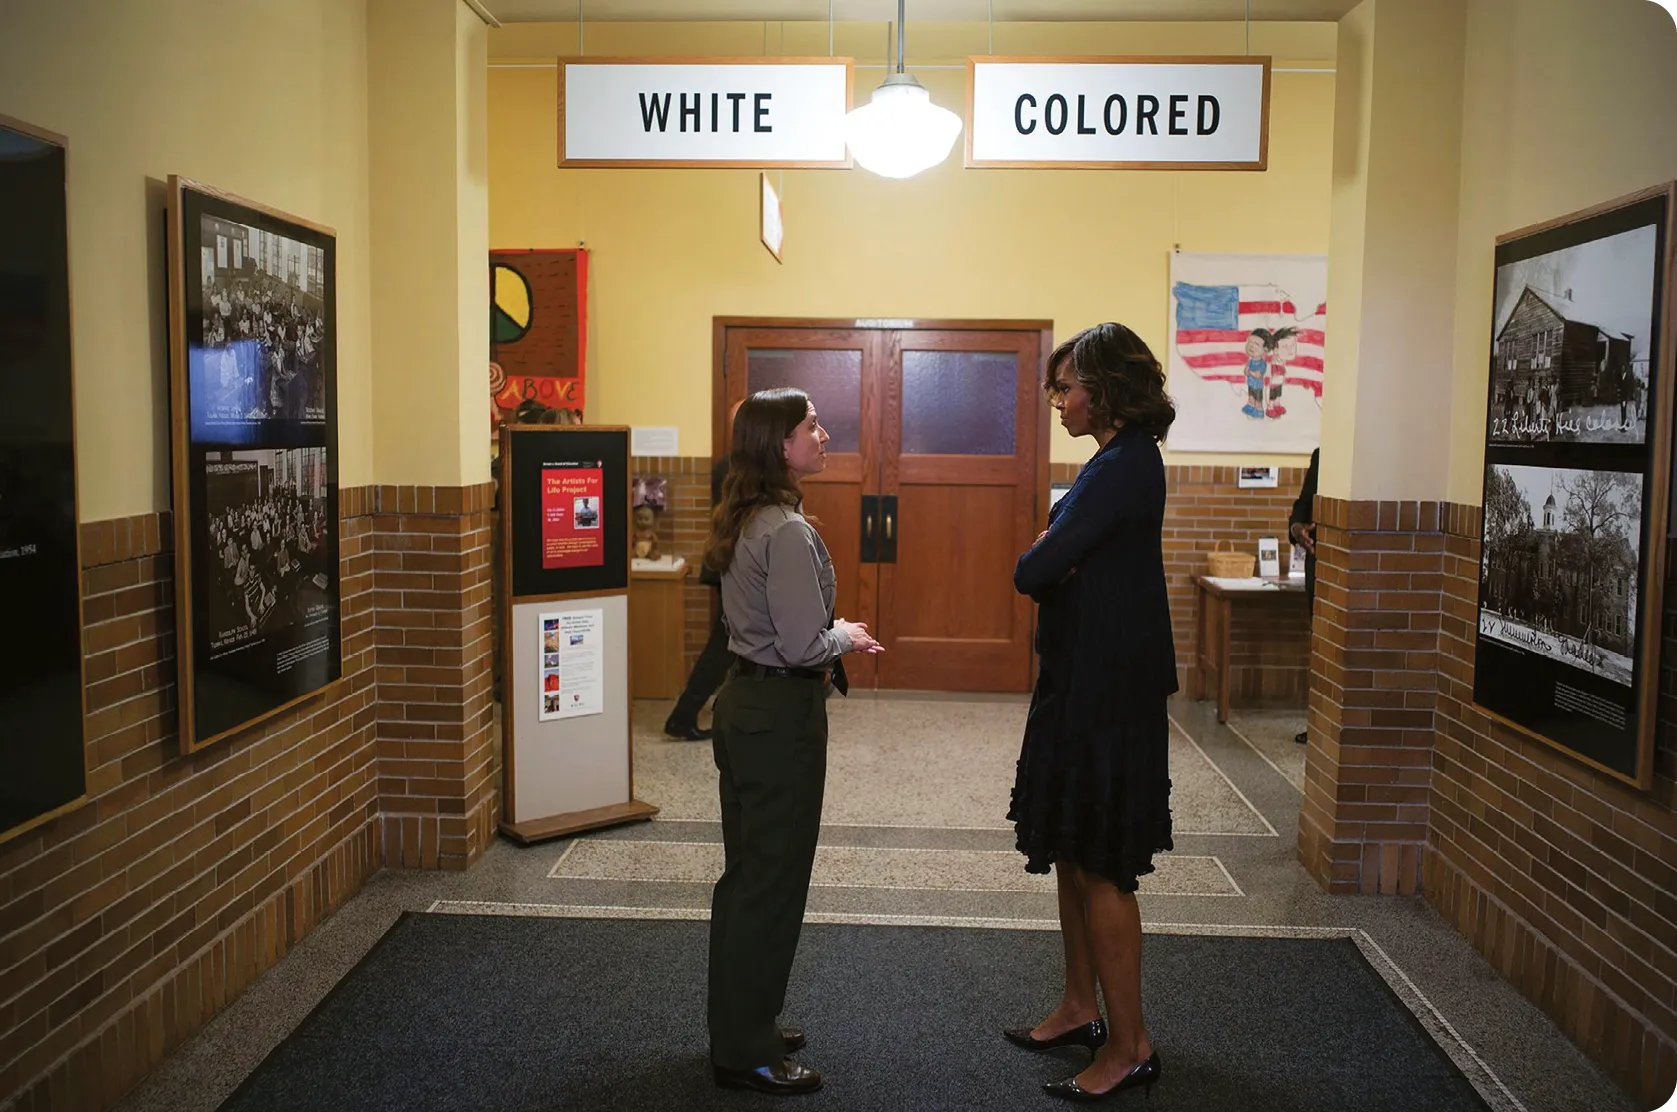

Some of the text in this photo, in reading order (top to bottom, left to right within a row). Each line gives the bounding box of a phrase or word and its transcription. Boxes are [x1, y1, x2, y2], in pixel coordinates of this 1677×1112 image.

[639, 93, 772, 133] WHITE
[1015, 93, 1220, 136] COLORED
[547, 486, 587, 495] Life Project
[562, 477, 586, 485] Artists
[587, 476, 598, 485] For
